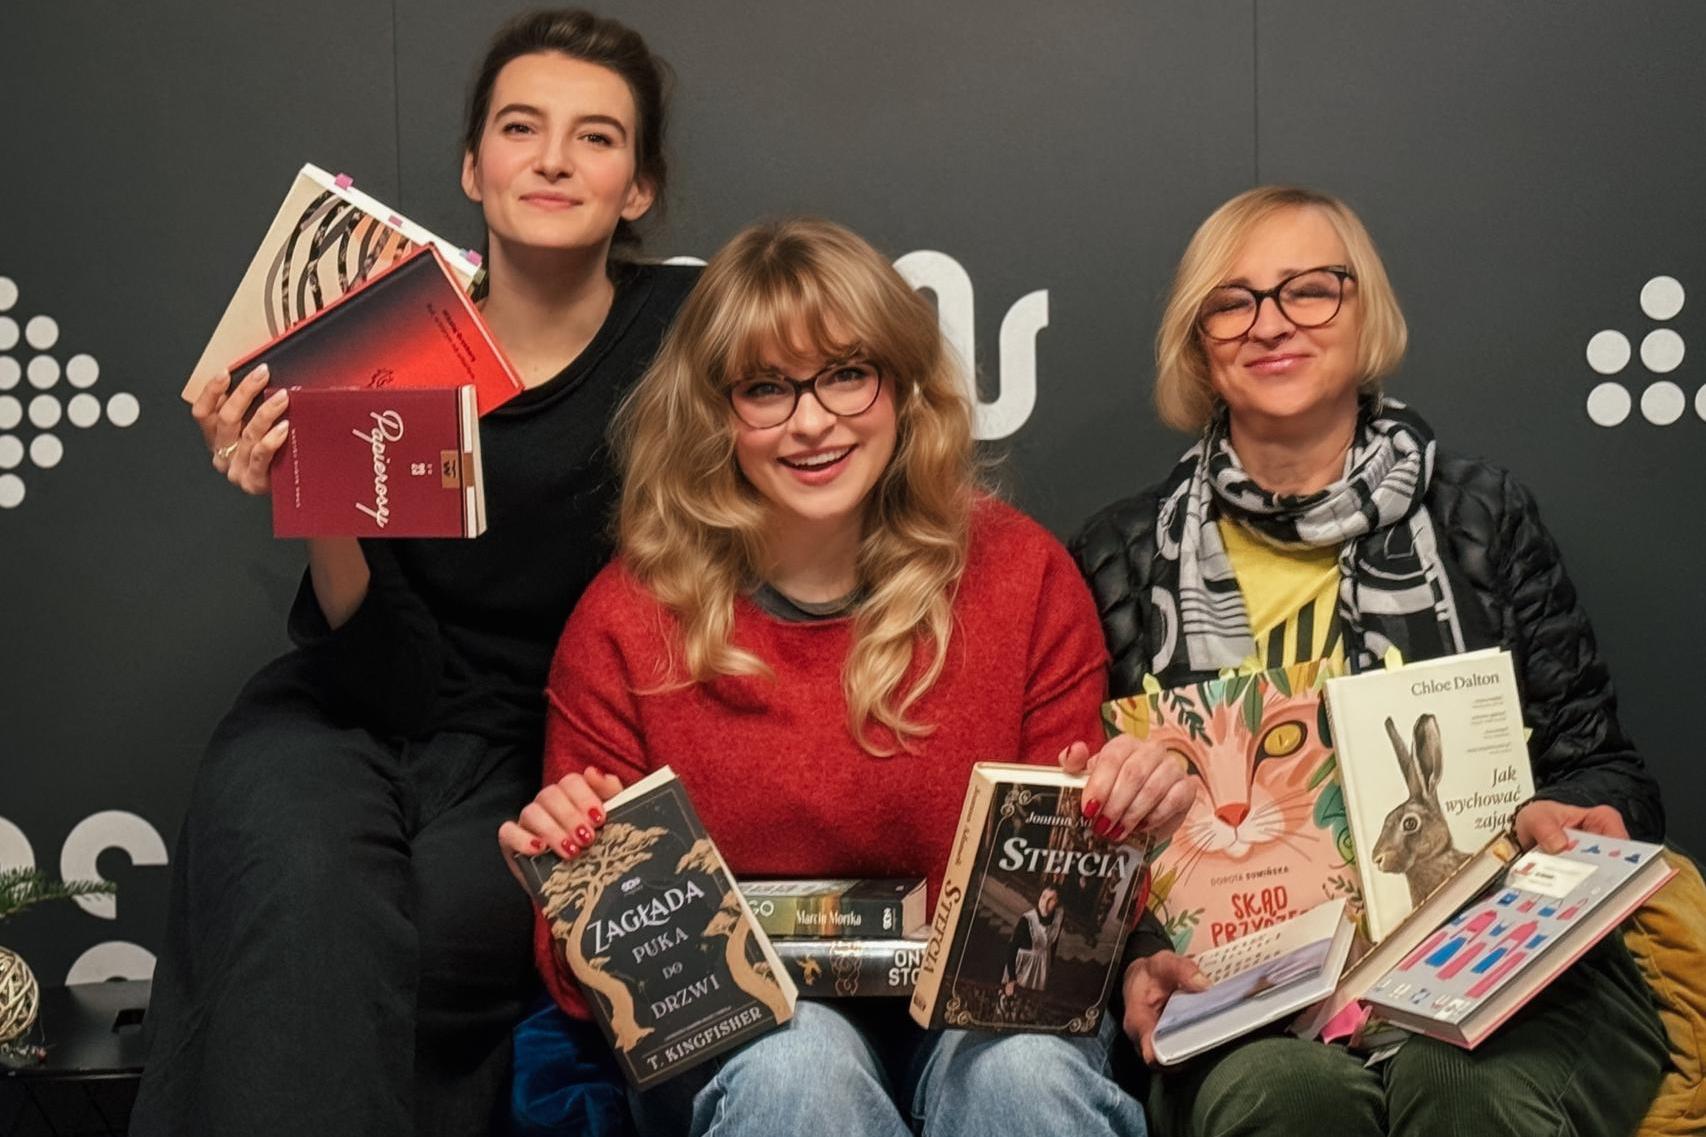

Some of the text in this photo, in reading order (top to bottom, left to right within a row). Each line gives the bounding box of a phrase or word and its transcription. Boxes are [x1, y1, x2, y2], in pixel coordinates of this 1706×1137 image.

[352, 410, 404, 528] Papierosy
[1411, 672, 1500, 697] Chloe Dalton
[1491, 764, 1518, 788] Jak
[1445, 784, 1522, 815] wychować
[1025, 811, 1073, 826] Joanna
[998, 836, 1128, 879] STEFCIA
[586, 879, 706, 954] ZAGŁADA
[796, 909, 827, 926] Marcin
[1230, 885, 1289, 920] SKĄD
[923, 877, 962, 974] STEFCIA
[631, 926, 690, 964] PUKA
[661, 961, 684, 980] DO
[888, 967, 920, 987] STO
[650, 974, 721, 1020] DRZWI
[646, 1055, 665, 1071] T.
[664, 1005, 763, 1064] KINGFISHER
